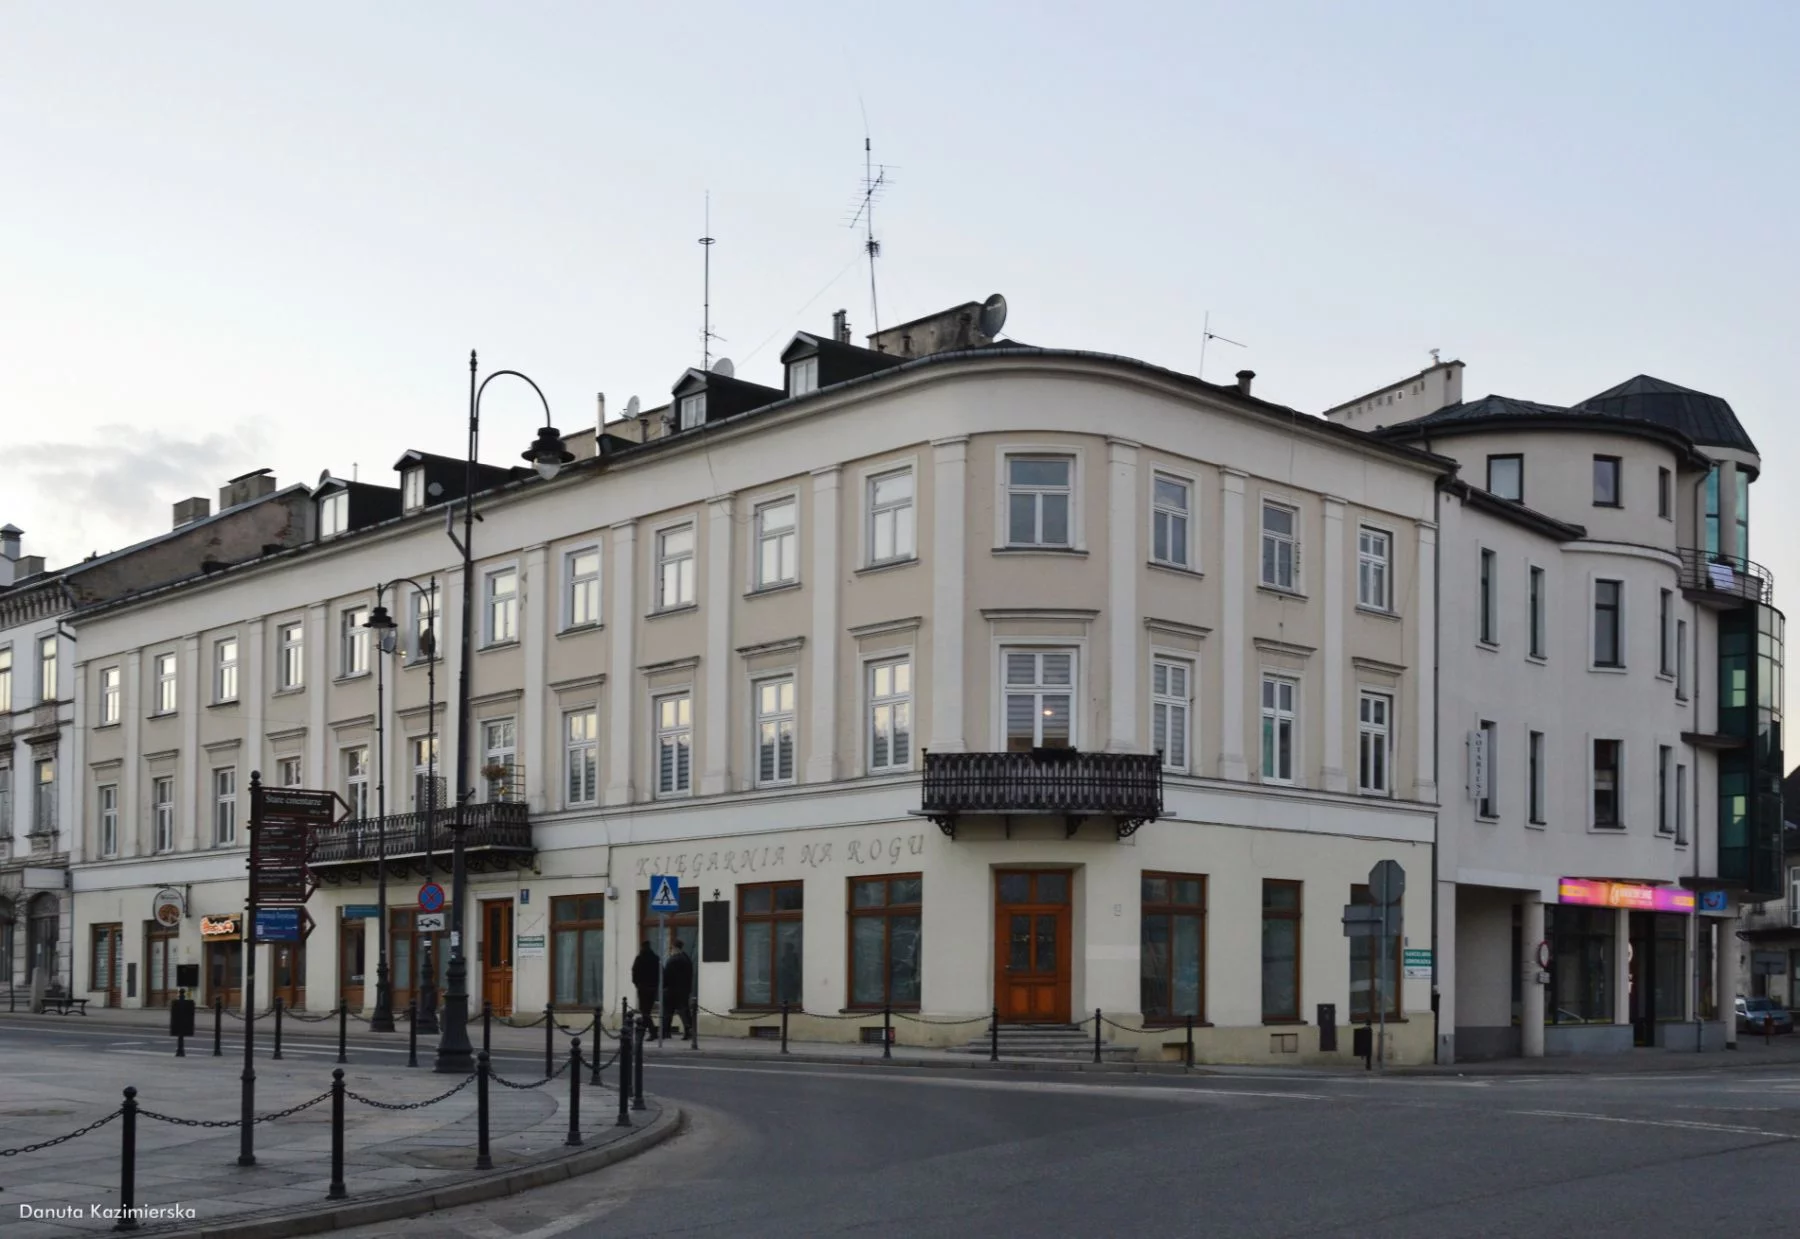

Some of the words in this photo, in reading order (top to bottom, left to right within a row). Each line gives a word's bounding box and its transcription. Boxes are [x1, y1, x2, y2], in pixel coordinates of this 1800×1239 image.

[636, 845, 786, 879] KSIĘGARNIA
[800, 842, 833, 868] NA
[847, 833, 925, 866] ROGU
